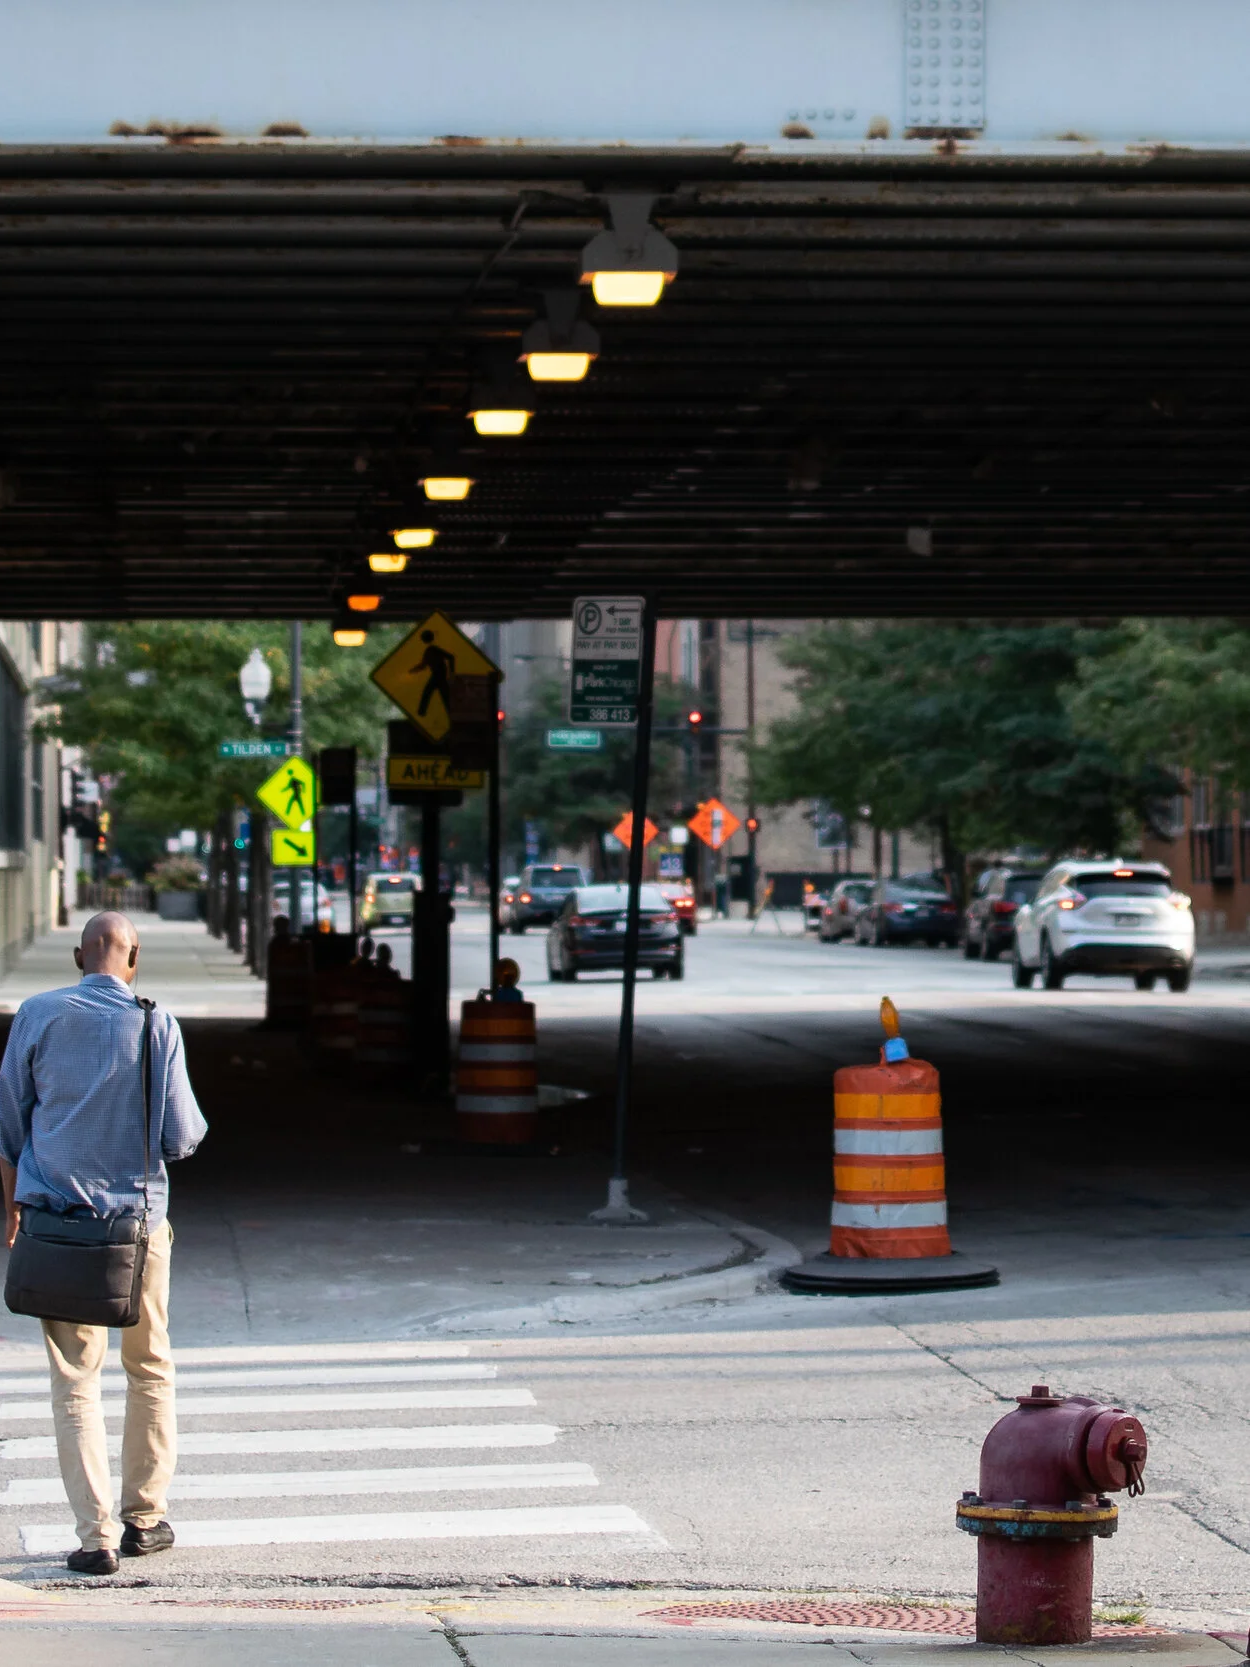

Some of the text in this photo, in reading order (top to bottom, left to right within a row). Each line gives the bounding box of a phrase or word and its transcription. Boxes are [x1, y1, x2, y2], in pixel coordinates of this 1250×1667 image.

[576, 640, 637, 649] PAY AT PAY BOX
[610, 708, 631, 721] 413
[232, 743, 271, 755] TILDEN
[402, 763, 469, 781] AHEAD
